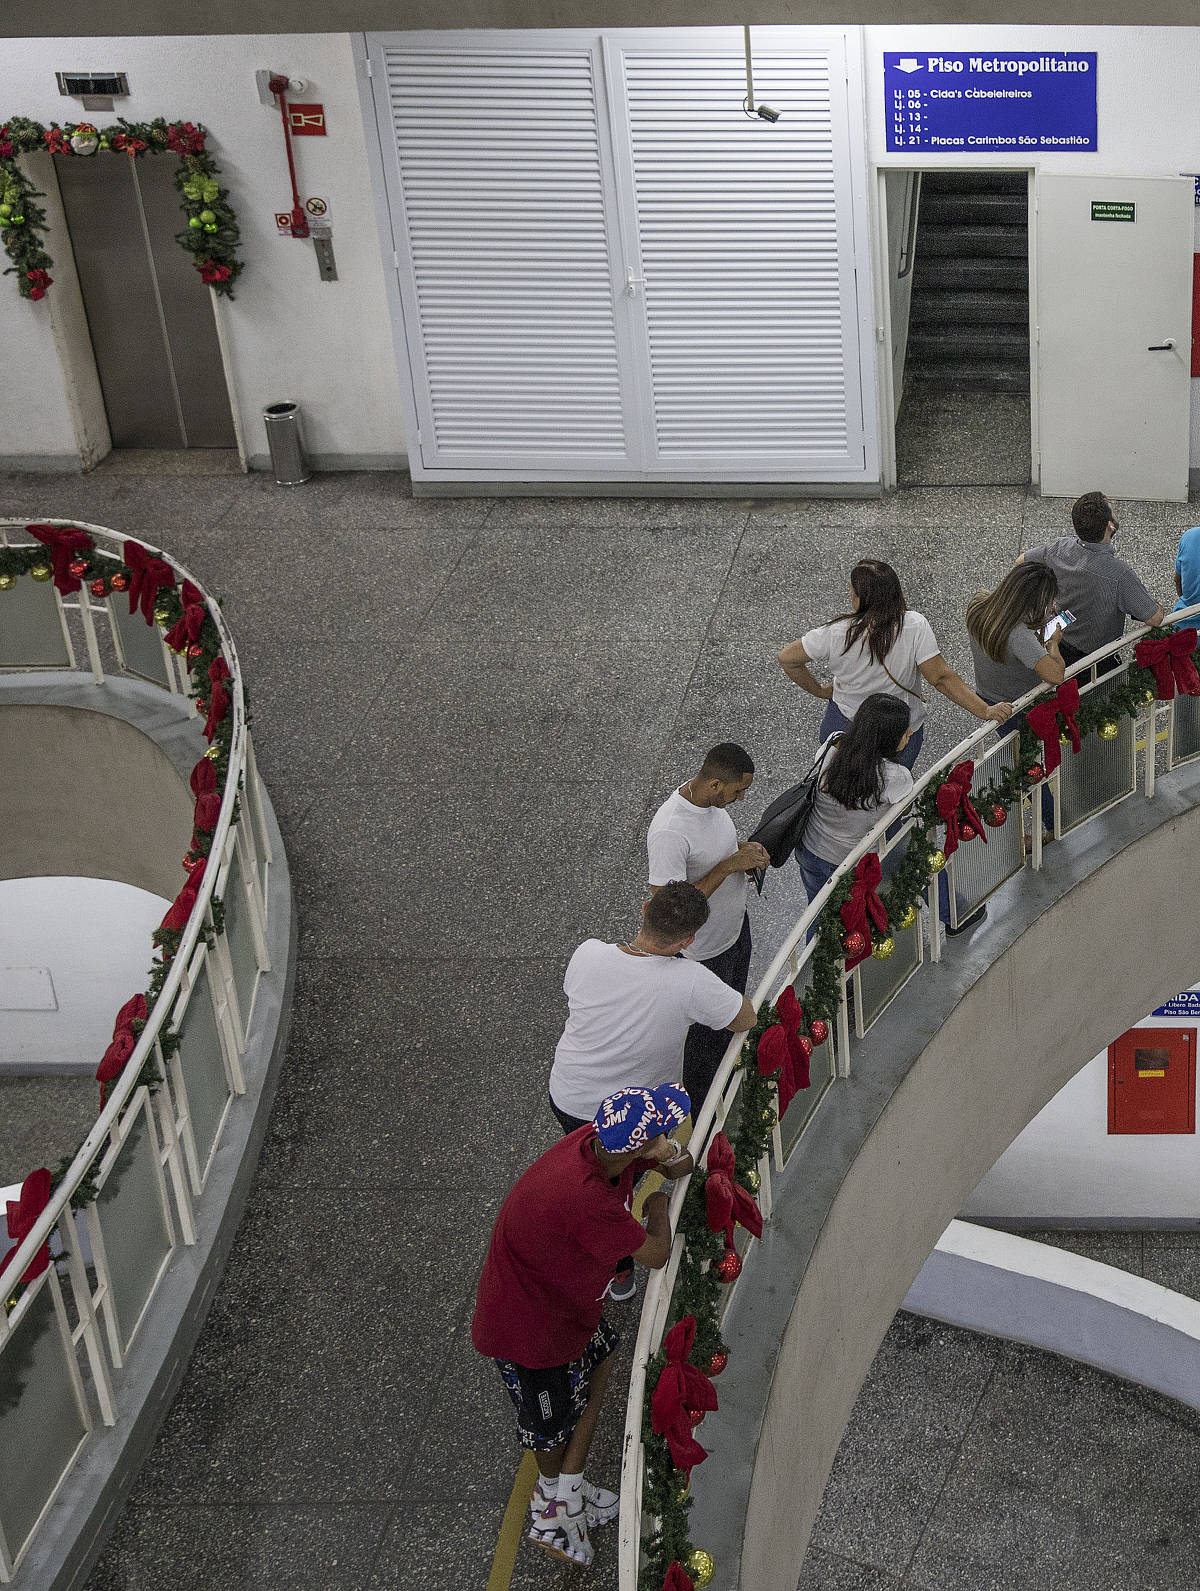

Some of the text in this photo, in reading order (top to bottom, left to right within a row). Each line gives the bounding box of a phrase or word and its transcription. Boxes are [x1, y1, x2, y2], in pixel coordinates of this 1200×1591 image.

[927, 57, 1090, 76] Piso Metropolitano
[894, 89, 905, 100] Lj.
[907, 89, 921, 99] 05
[930, 89, 962, 99] Cida's
[964, 88, 1032, 99] Cabeleireiros
[894, 100, 905, 111] Lj.
[907, 100, 921, 109] 06
[894, 112, 905, 122] Lj.
[908, 112, 921, 121] 13
[894, 124, 905, 134] Lj.
[908, 124, 921, 133] 14
[894, 136, 906, 146] Lj.
[908, 136, 921, 145] 21
[931, 136, 965, 145] Placas
[967, 135, 1017, 145] Carimbos
[1018, 135, 1037, 145] São
[1040, 135, 1090, 145] Sebastião
[1171, 994, 1199, 1002] IDA
